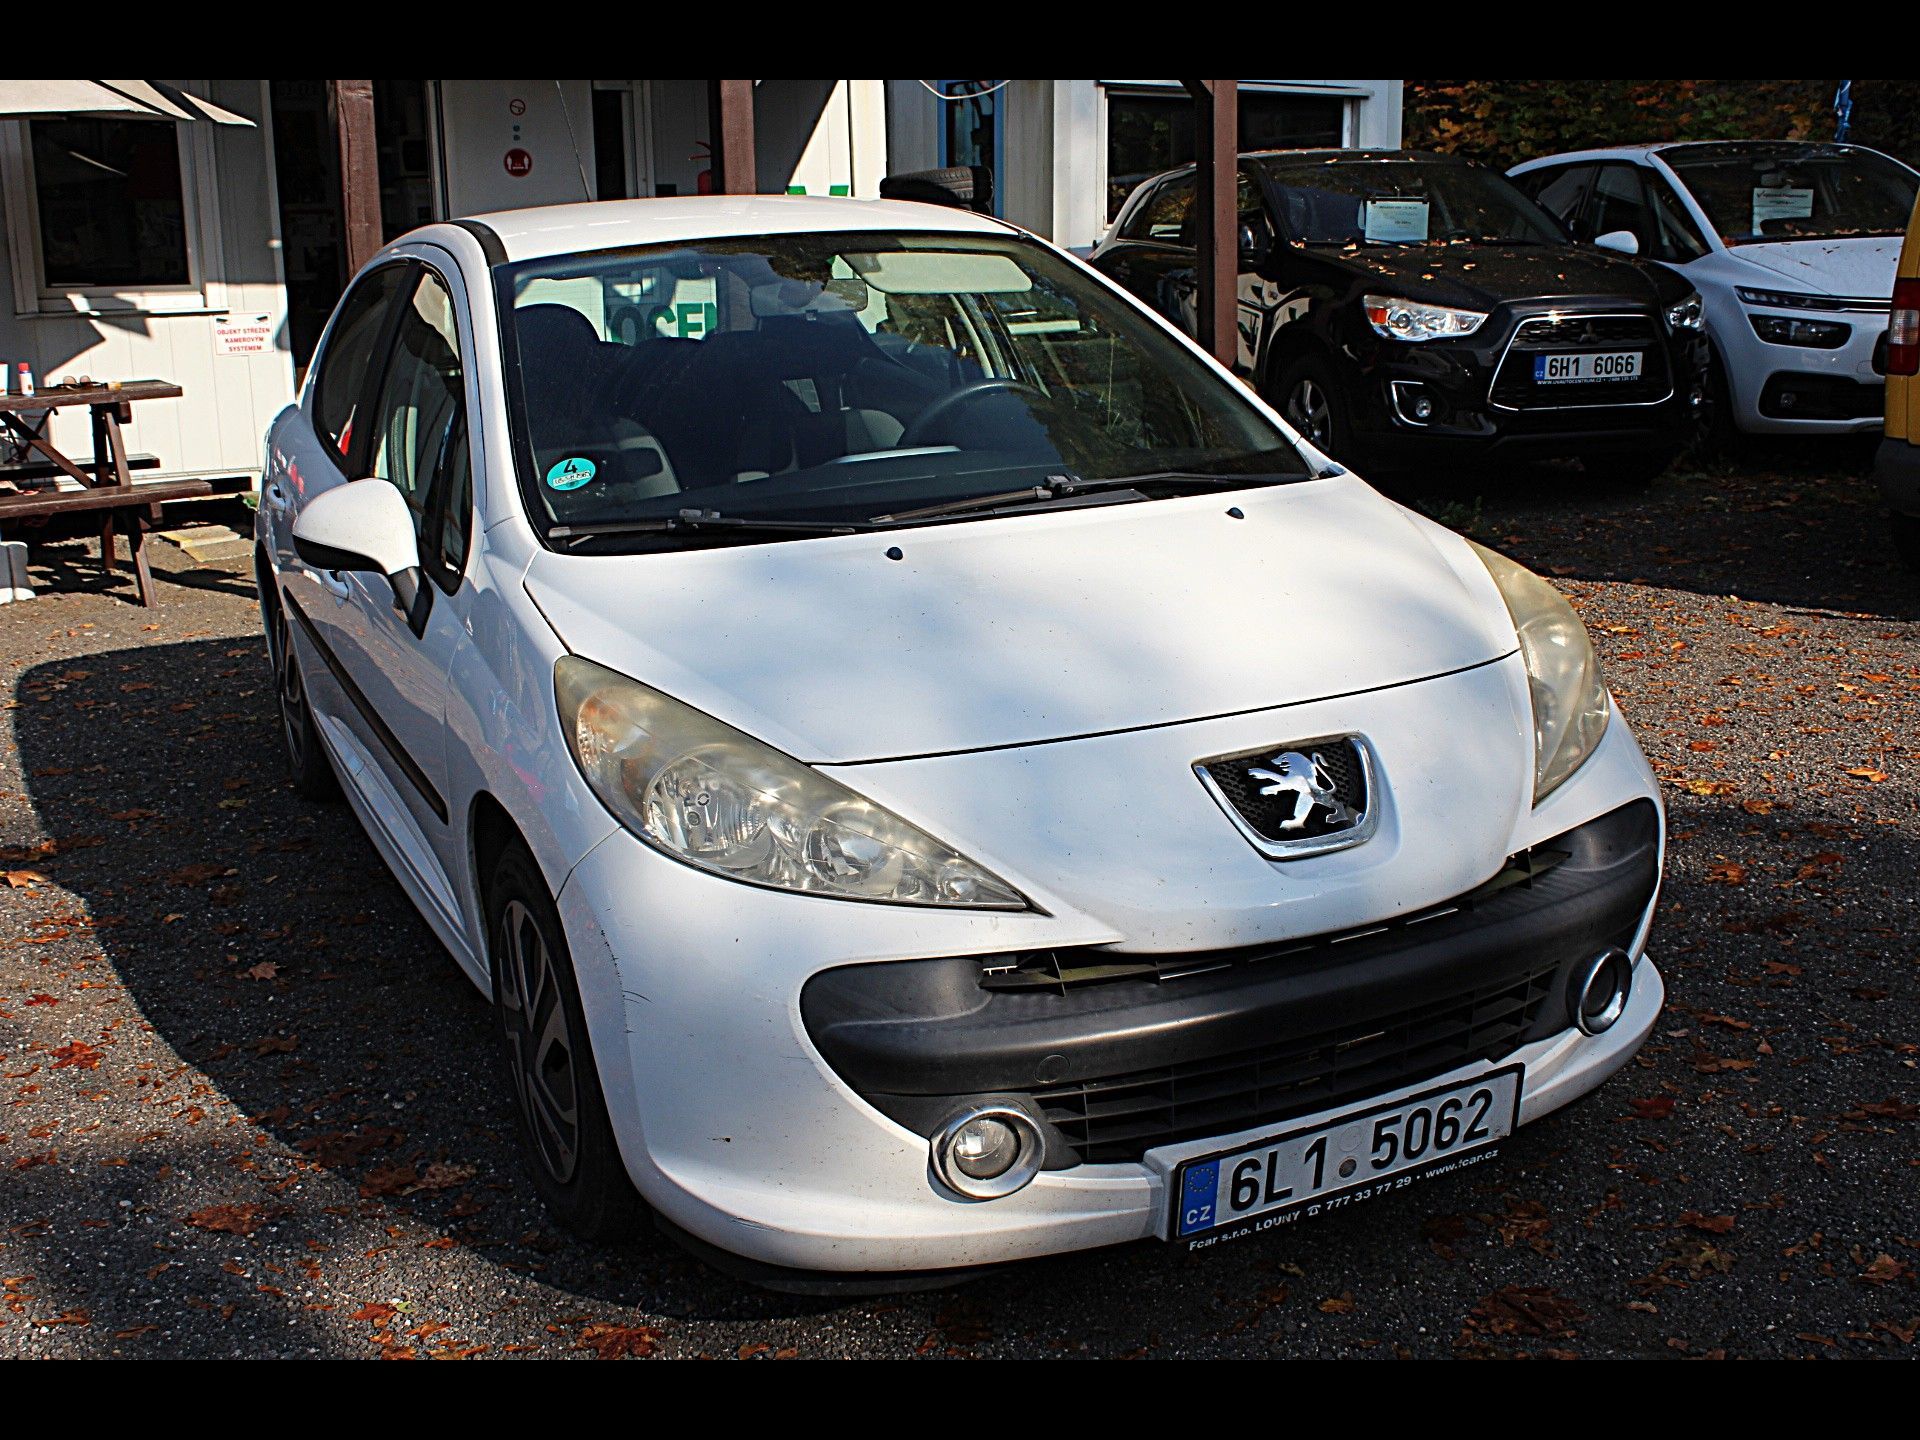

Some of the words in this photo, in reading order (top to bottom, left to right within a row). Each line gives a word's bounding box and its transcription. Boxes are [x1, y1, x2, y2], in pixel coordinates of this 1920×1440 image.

[1548, 356, 1580, 377] 6H1
[1594, 354, 1635, 375] 6066
[563, 459, 578, 473] 4
[1229, 1136, 1327, 1212] 6L1
[1370, 1087, 1493, 1171] 5062
[1186, 1204, 1211, 1225] CZ
[1189, 1236, 1218, 1251] Fcar
[1221, 1228, 1252, 1242] s.r.o.
[1255, 1210, 1301, 1232] LOUNY
[1326, 1195, 1350, 1211] 777
[1354, 1189, 1372, 1201] 33
[1376, 1182, 1392, 1195] 77
[1395, 1176, 1412, 1189] 29
